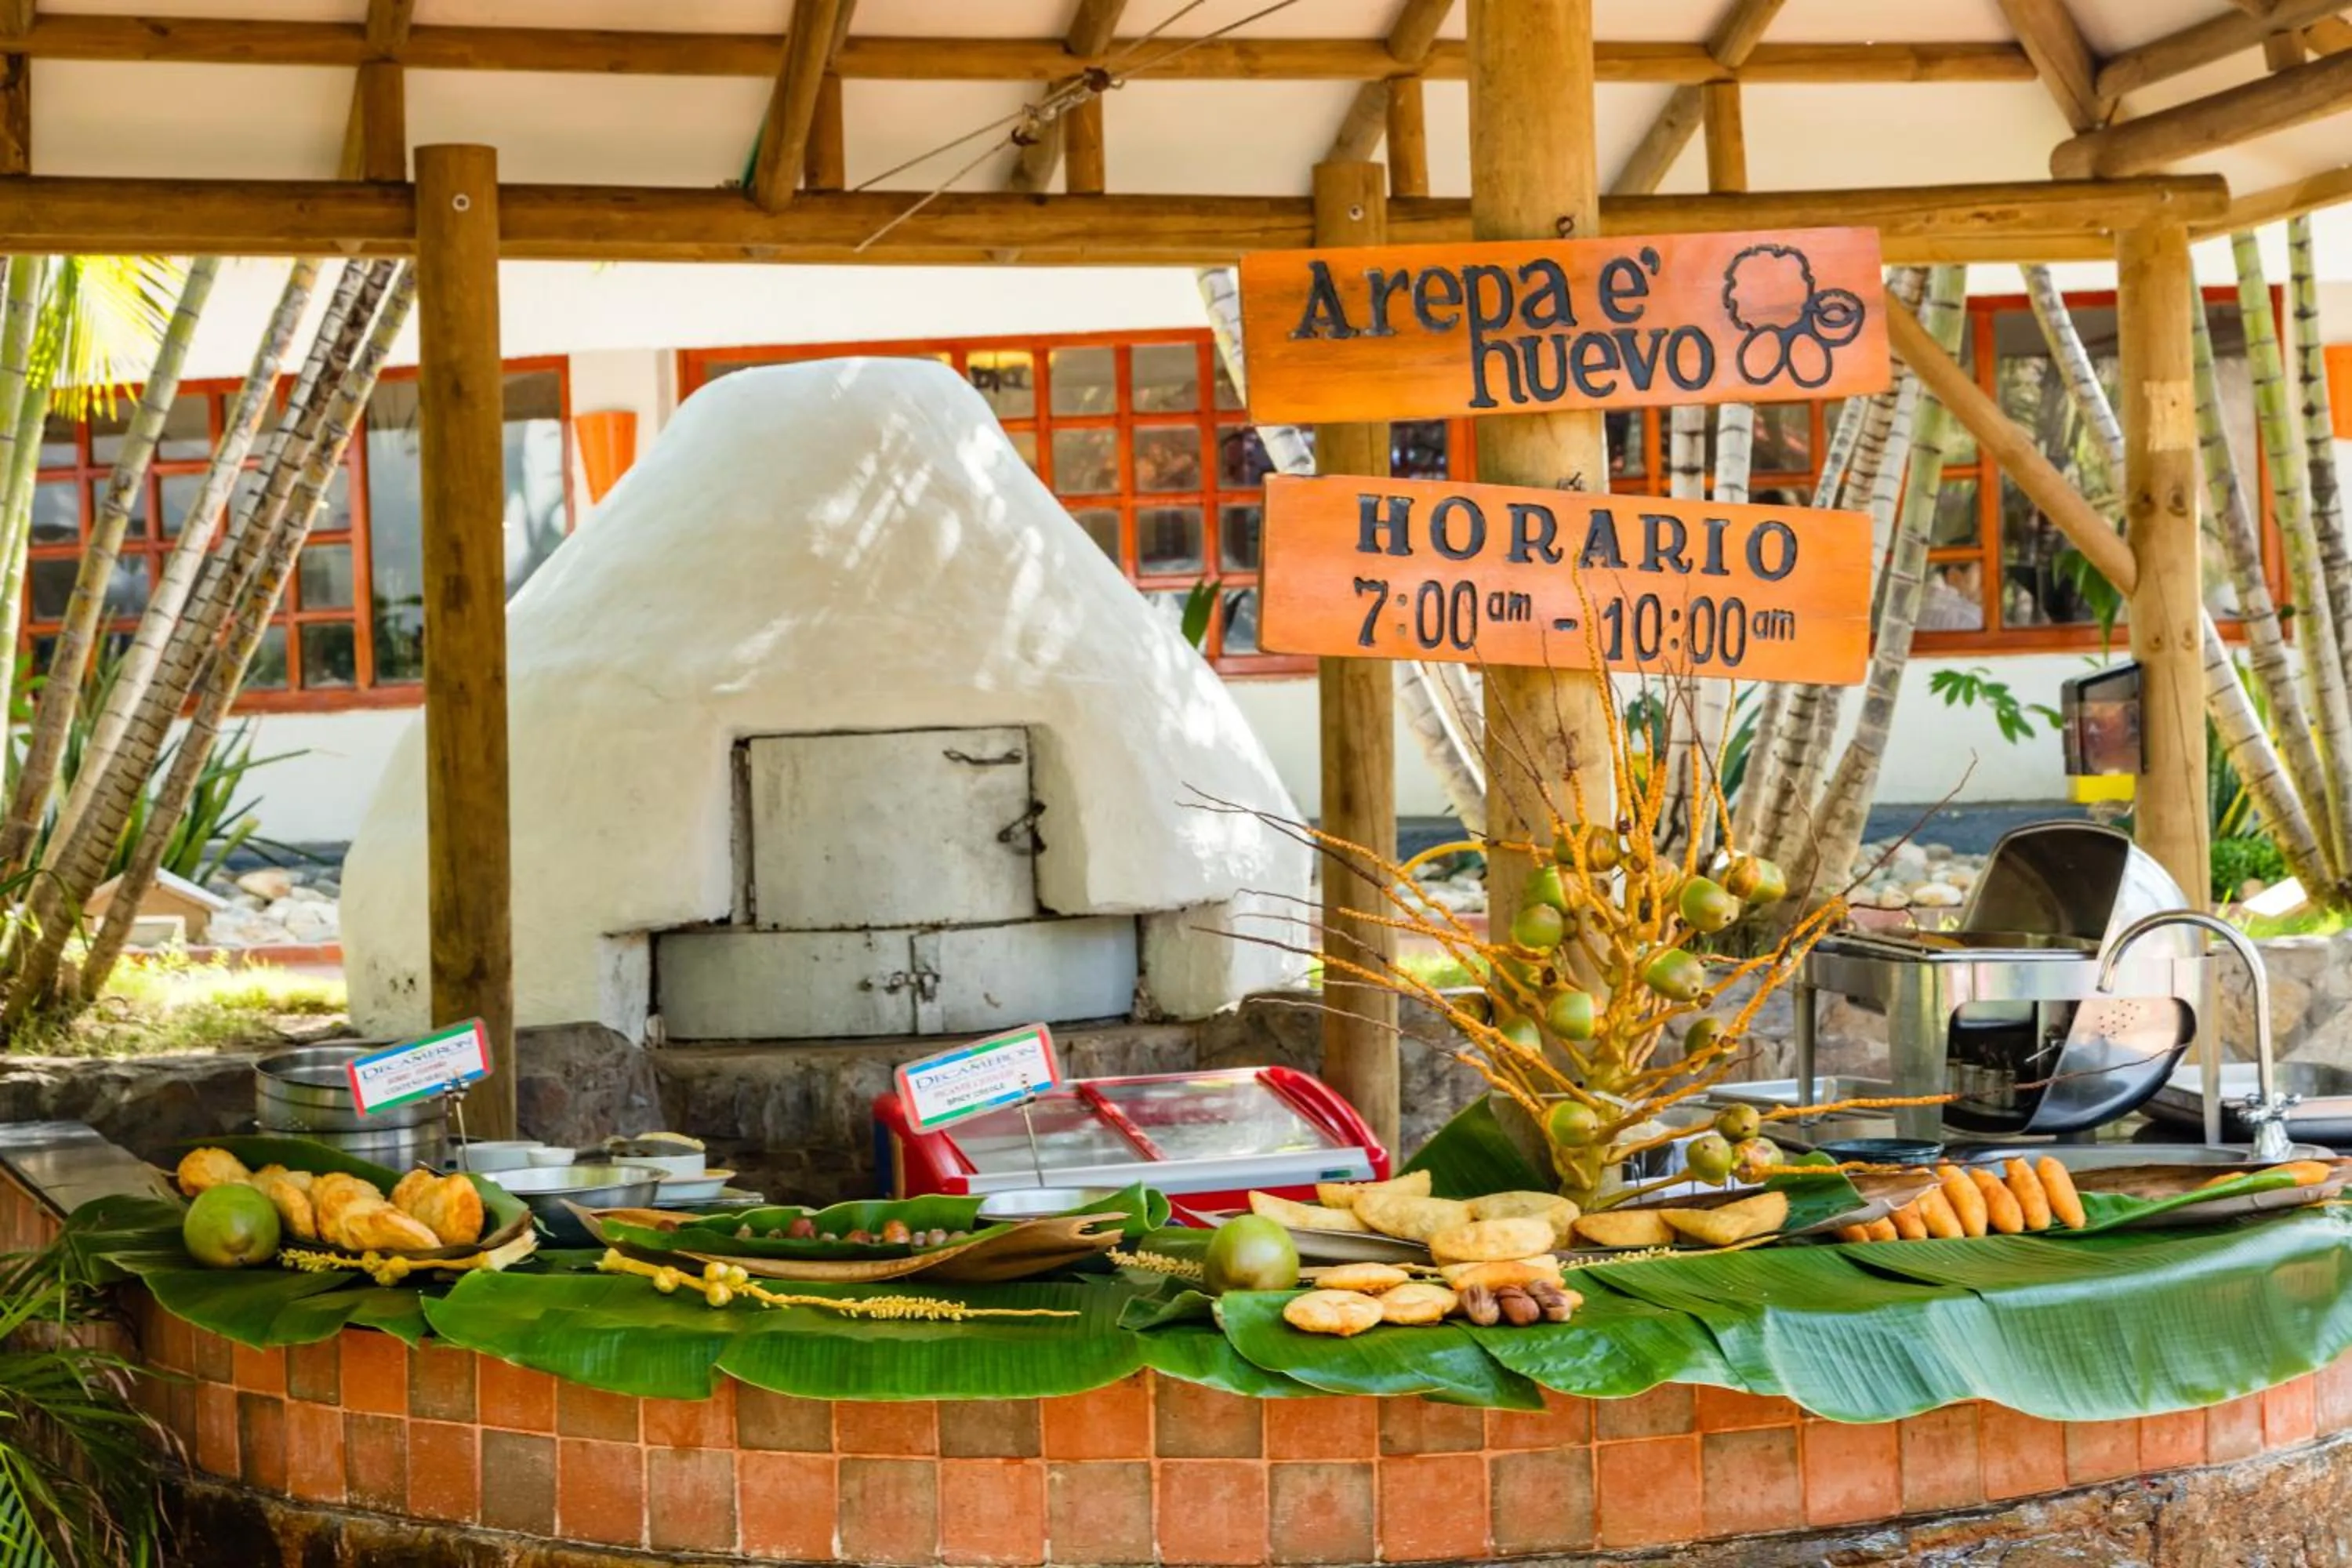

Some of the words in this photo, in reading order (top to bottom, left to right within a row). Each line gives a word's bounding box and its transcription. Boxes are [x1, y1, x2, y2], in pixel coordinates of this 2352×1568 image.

[1288, 257, 1578, 343] Arepa
[1468, 325, 1716, 408] huevo
[1355, 492, 1798, 582] HORARIO
